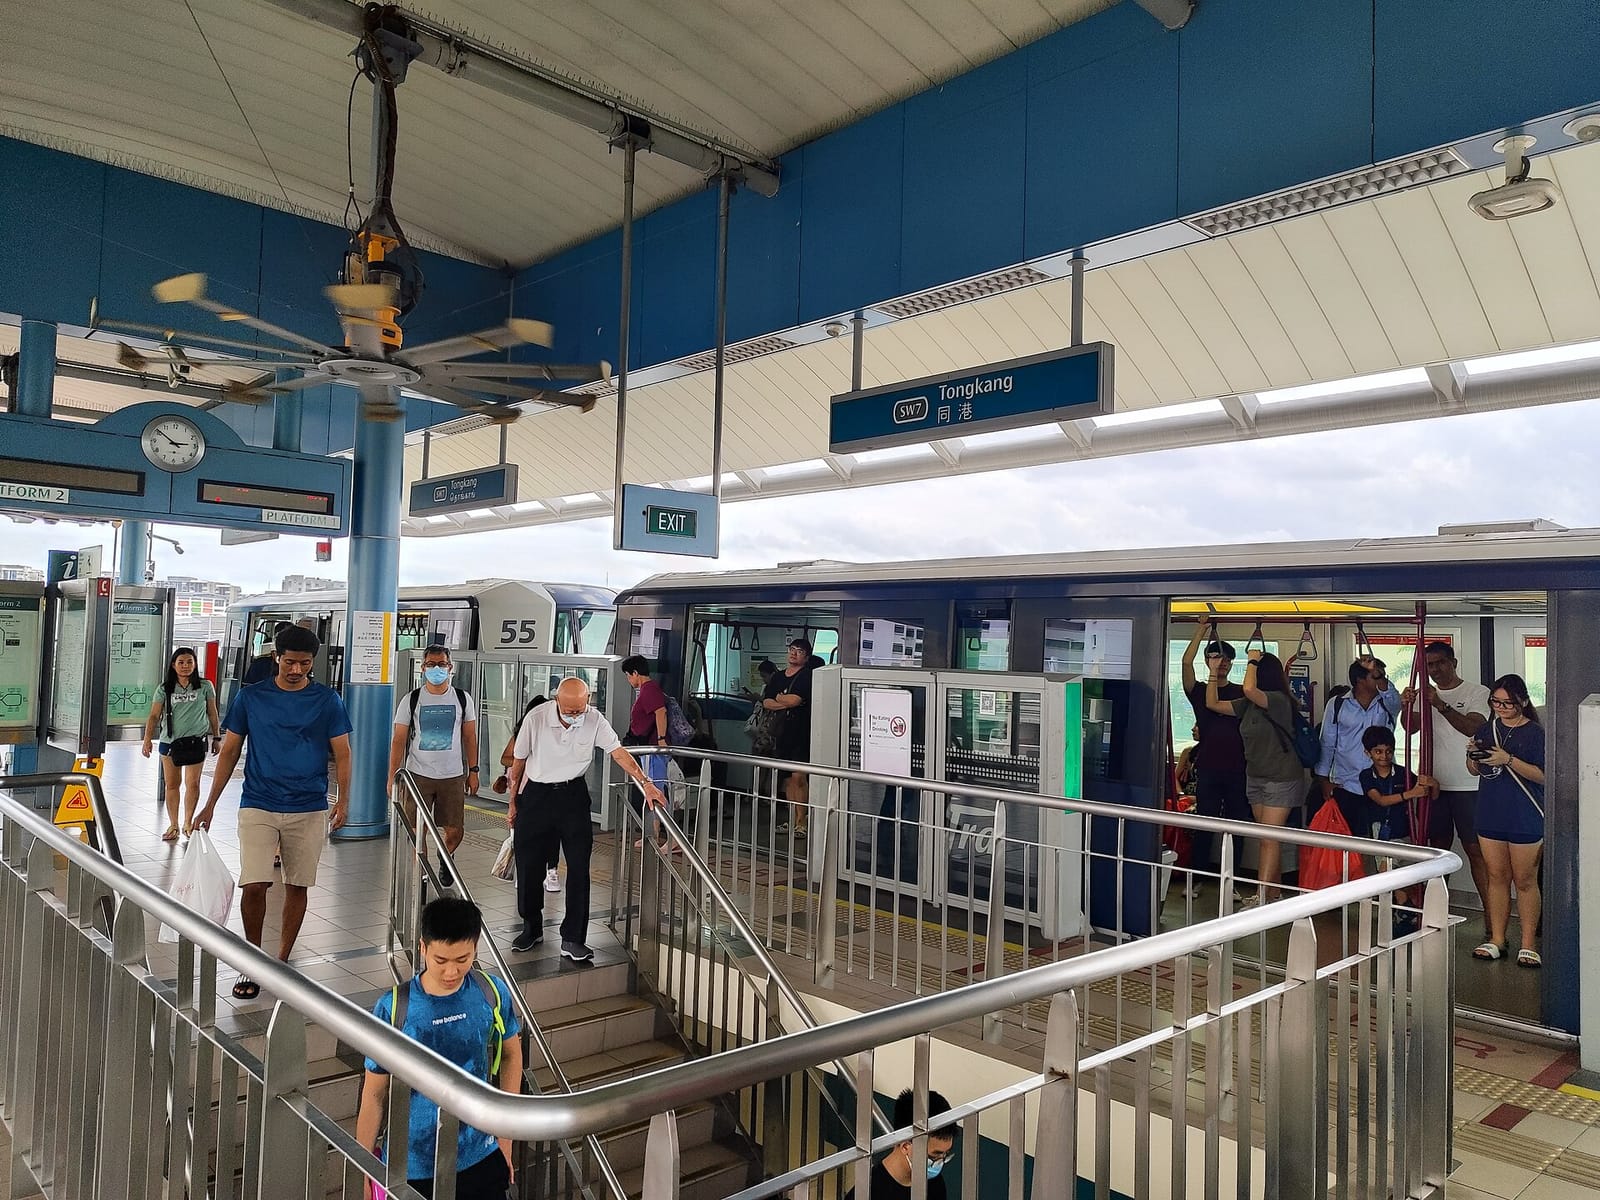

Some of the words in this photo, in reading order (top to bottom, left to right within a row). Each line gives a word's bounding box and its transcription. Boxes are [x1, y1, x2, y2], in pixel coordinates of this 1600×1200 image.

[939, 375, 1013, 401] Tongkang
[899, 402, 923, 418] SW7
[937, 402, 973, 424] 同港
[451, 478, 478, 490] Tongkang
[56, 489, 65, 501] 2
[266, 511, 327, 526] PLATFORM
[658, 512, 688, 532] EXIT
[500, 619, 536, 644] 55
[444, 1013, 467, 1023] balance
